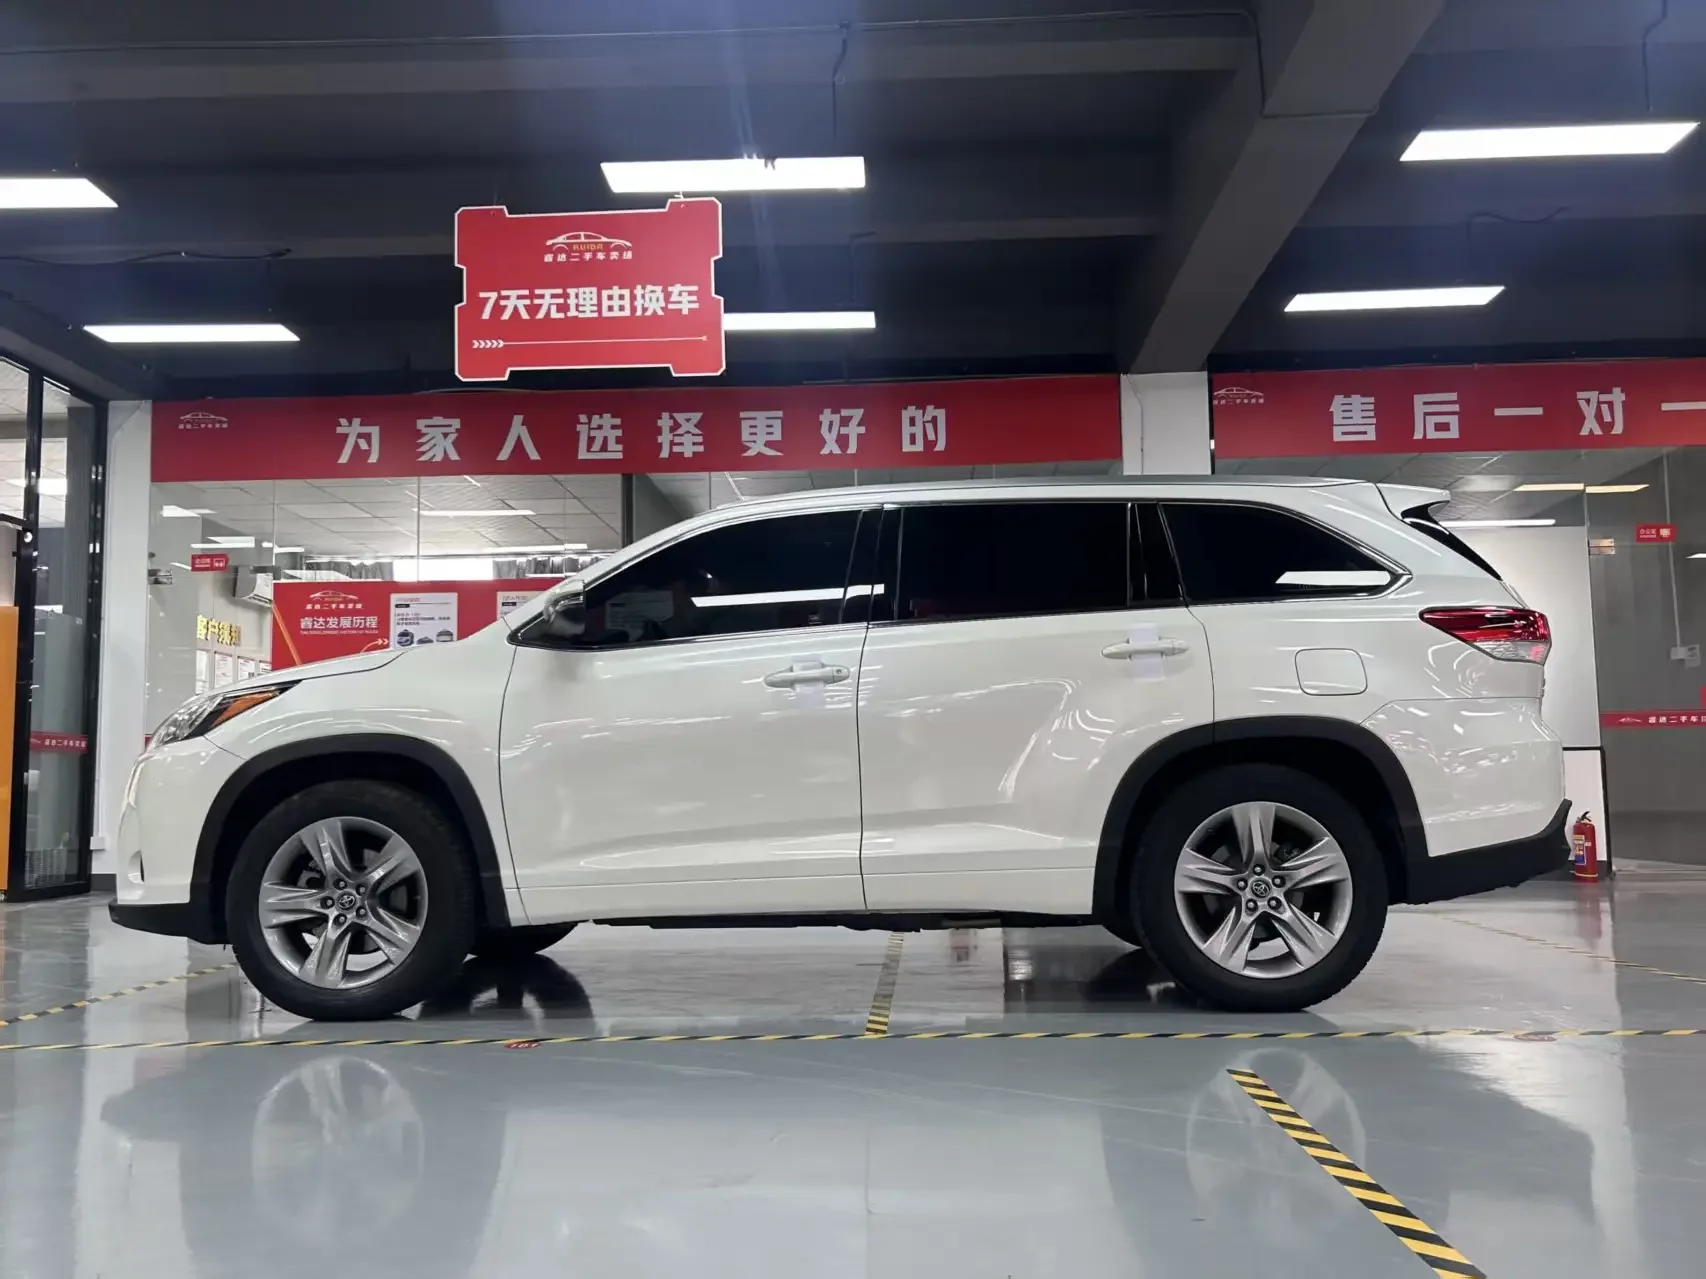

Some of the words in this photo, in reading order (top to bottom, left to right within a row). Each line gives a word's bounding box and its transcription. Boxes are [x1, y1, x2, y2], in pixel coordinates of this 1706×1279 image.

[479, 284, 699, 320] 7天无理由换车
[336, 405, 946, 464] 为家人选择更好的
[1330, 387, 1706, 441] 售后一对一
[300, 616, 378, 629] 睿达发展历程
